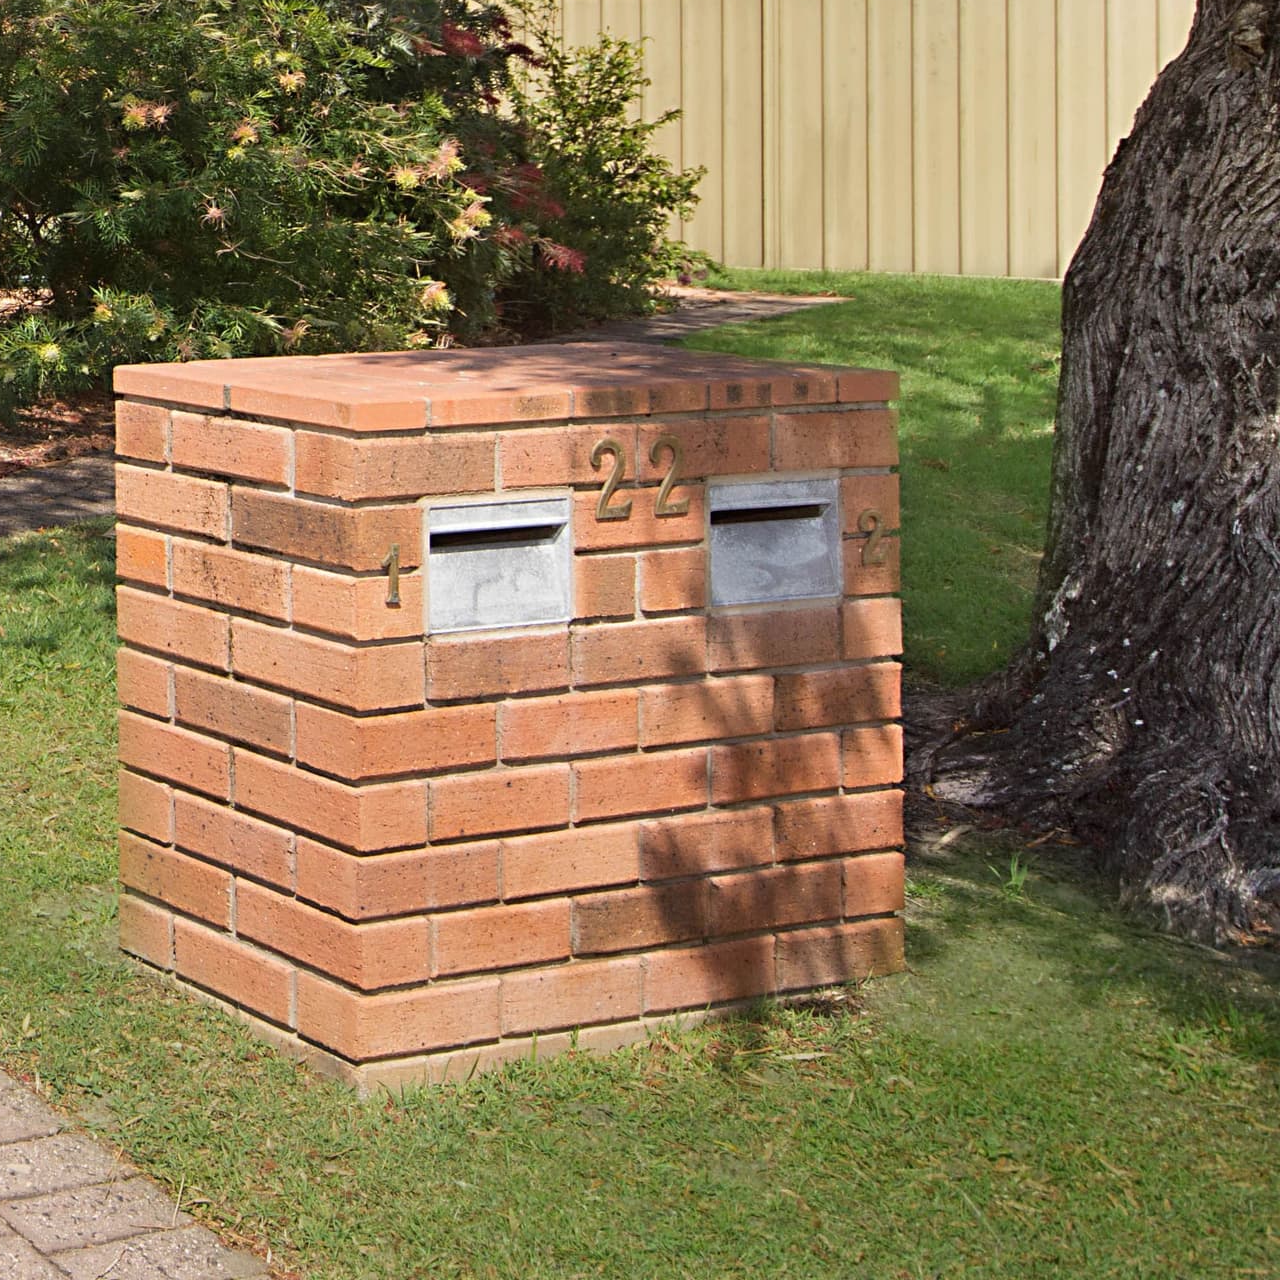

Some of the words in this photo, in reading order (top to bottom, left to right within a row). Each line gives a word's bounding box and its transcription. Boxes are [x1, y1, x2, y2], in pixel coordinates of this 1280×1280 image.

[590, 435, 690, 519] 22
[858, 508, 887, 565] 2
[381, 543, 401, 605] 1
